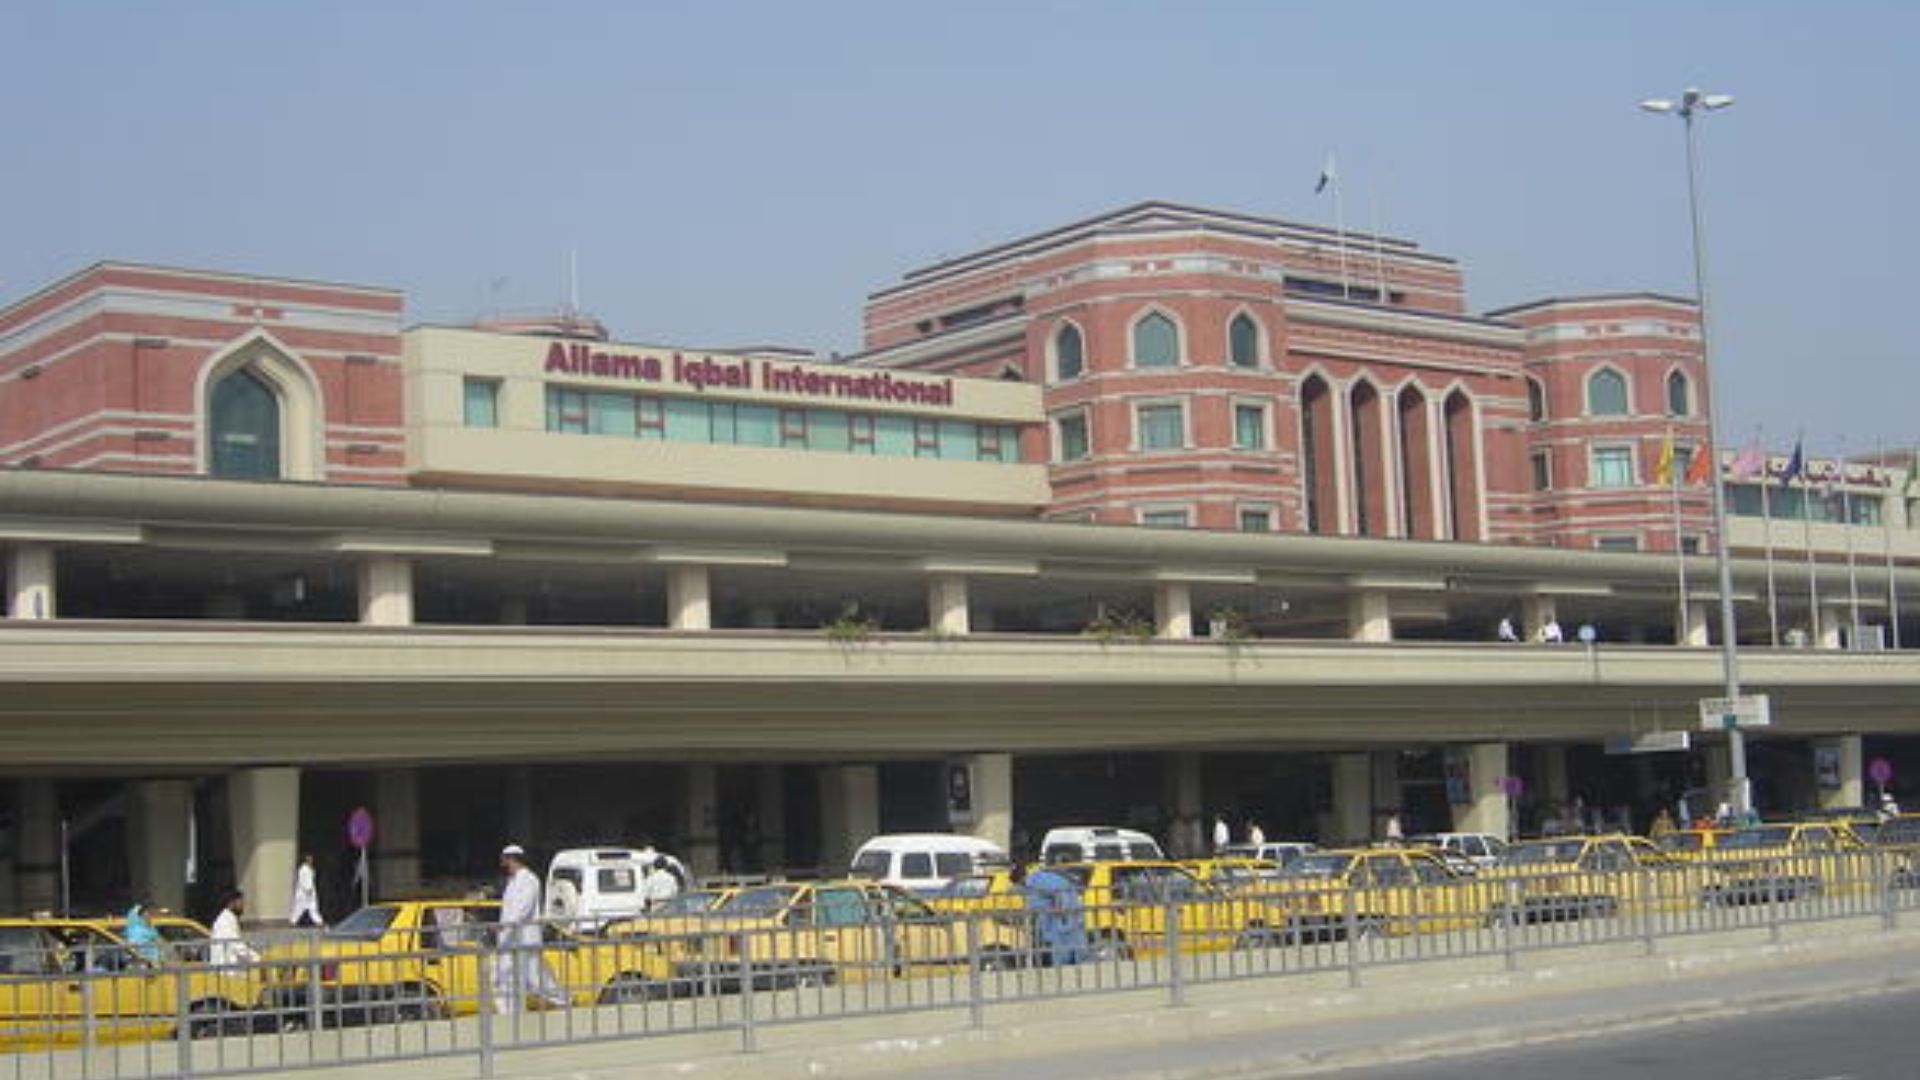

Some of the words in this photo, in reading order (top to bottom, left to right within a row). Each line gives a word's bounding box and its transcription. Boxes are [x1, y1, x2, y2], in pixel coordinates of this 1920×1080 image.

[545, 343, 661, 380] Allama
[674, 353, 750, 391] Iqbal
[763, 361, 953, 405] International
